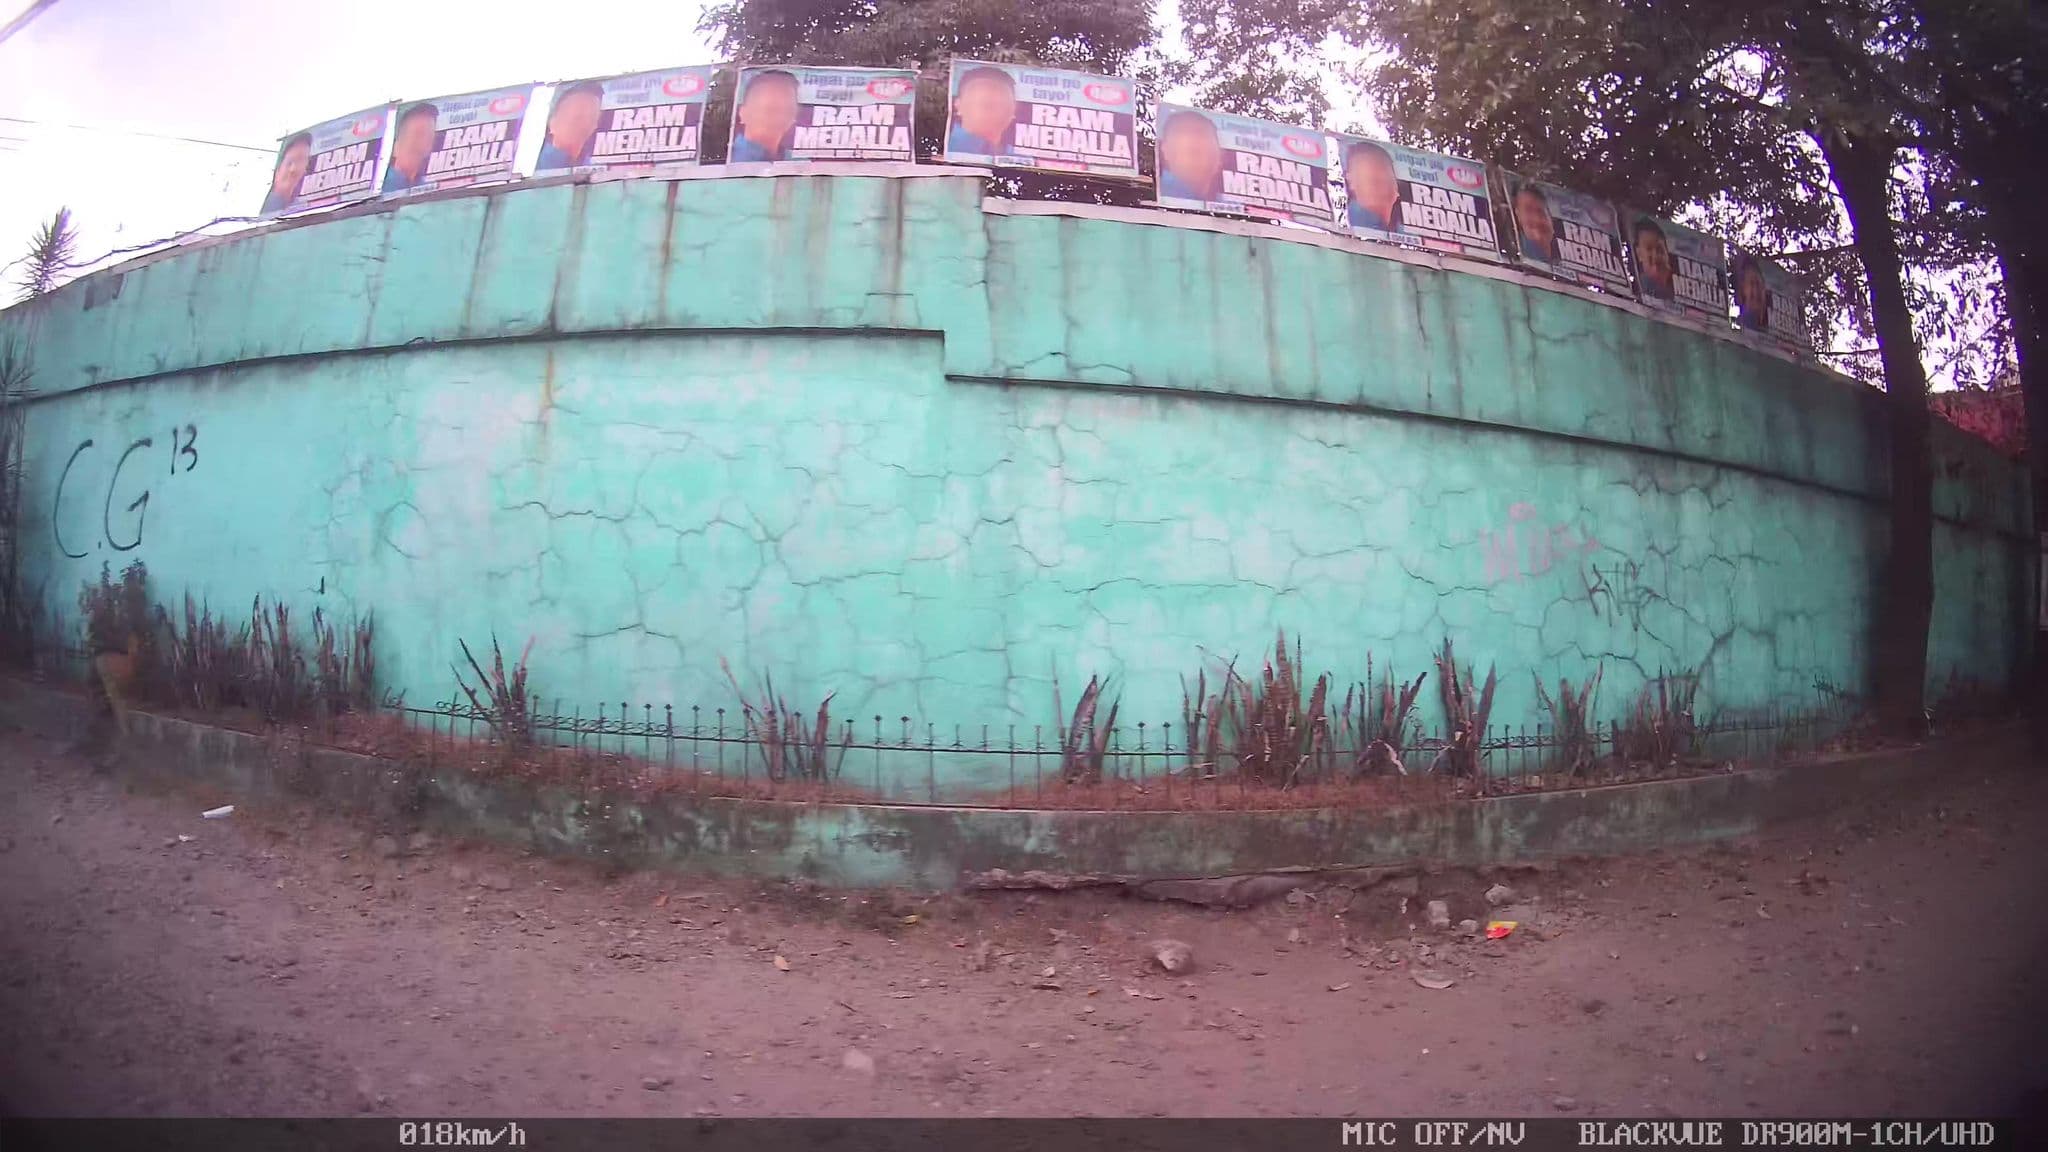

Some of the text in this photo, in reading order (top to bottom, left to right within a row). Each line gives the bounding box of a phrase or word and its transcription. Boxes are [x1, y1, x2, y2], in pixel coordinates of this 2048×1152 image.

[611, 104, 687, 131] RAM
[812, 104, 895, 126] RAM
[1031, 103, 1114, 133] RAM
[442, 121, 508, 150] RAM
[592, 126, 697, 156] MEDALLA
[793, 125, 911, 151] MEDALLA
[1014, 122, 1132, 160] MEDALLA
[314, 142, 369, 173] RAM
[426, 140, 514, 174] MEDALLA
[1235, 151, 1313, 186] RAM
[300, 159, 374, 196] MEDALLA
[1222, 169, 1332, 212] MEDALLA
[1410, 182, 1477, 217] RAM
[1400, 201, 1495, 243] MEDALLA
[1562, 220, 1612, 254] RAM
[1555, 237, 1627, 279] MEDALLA
